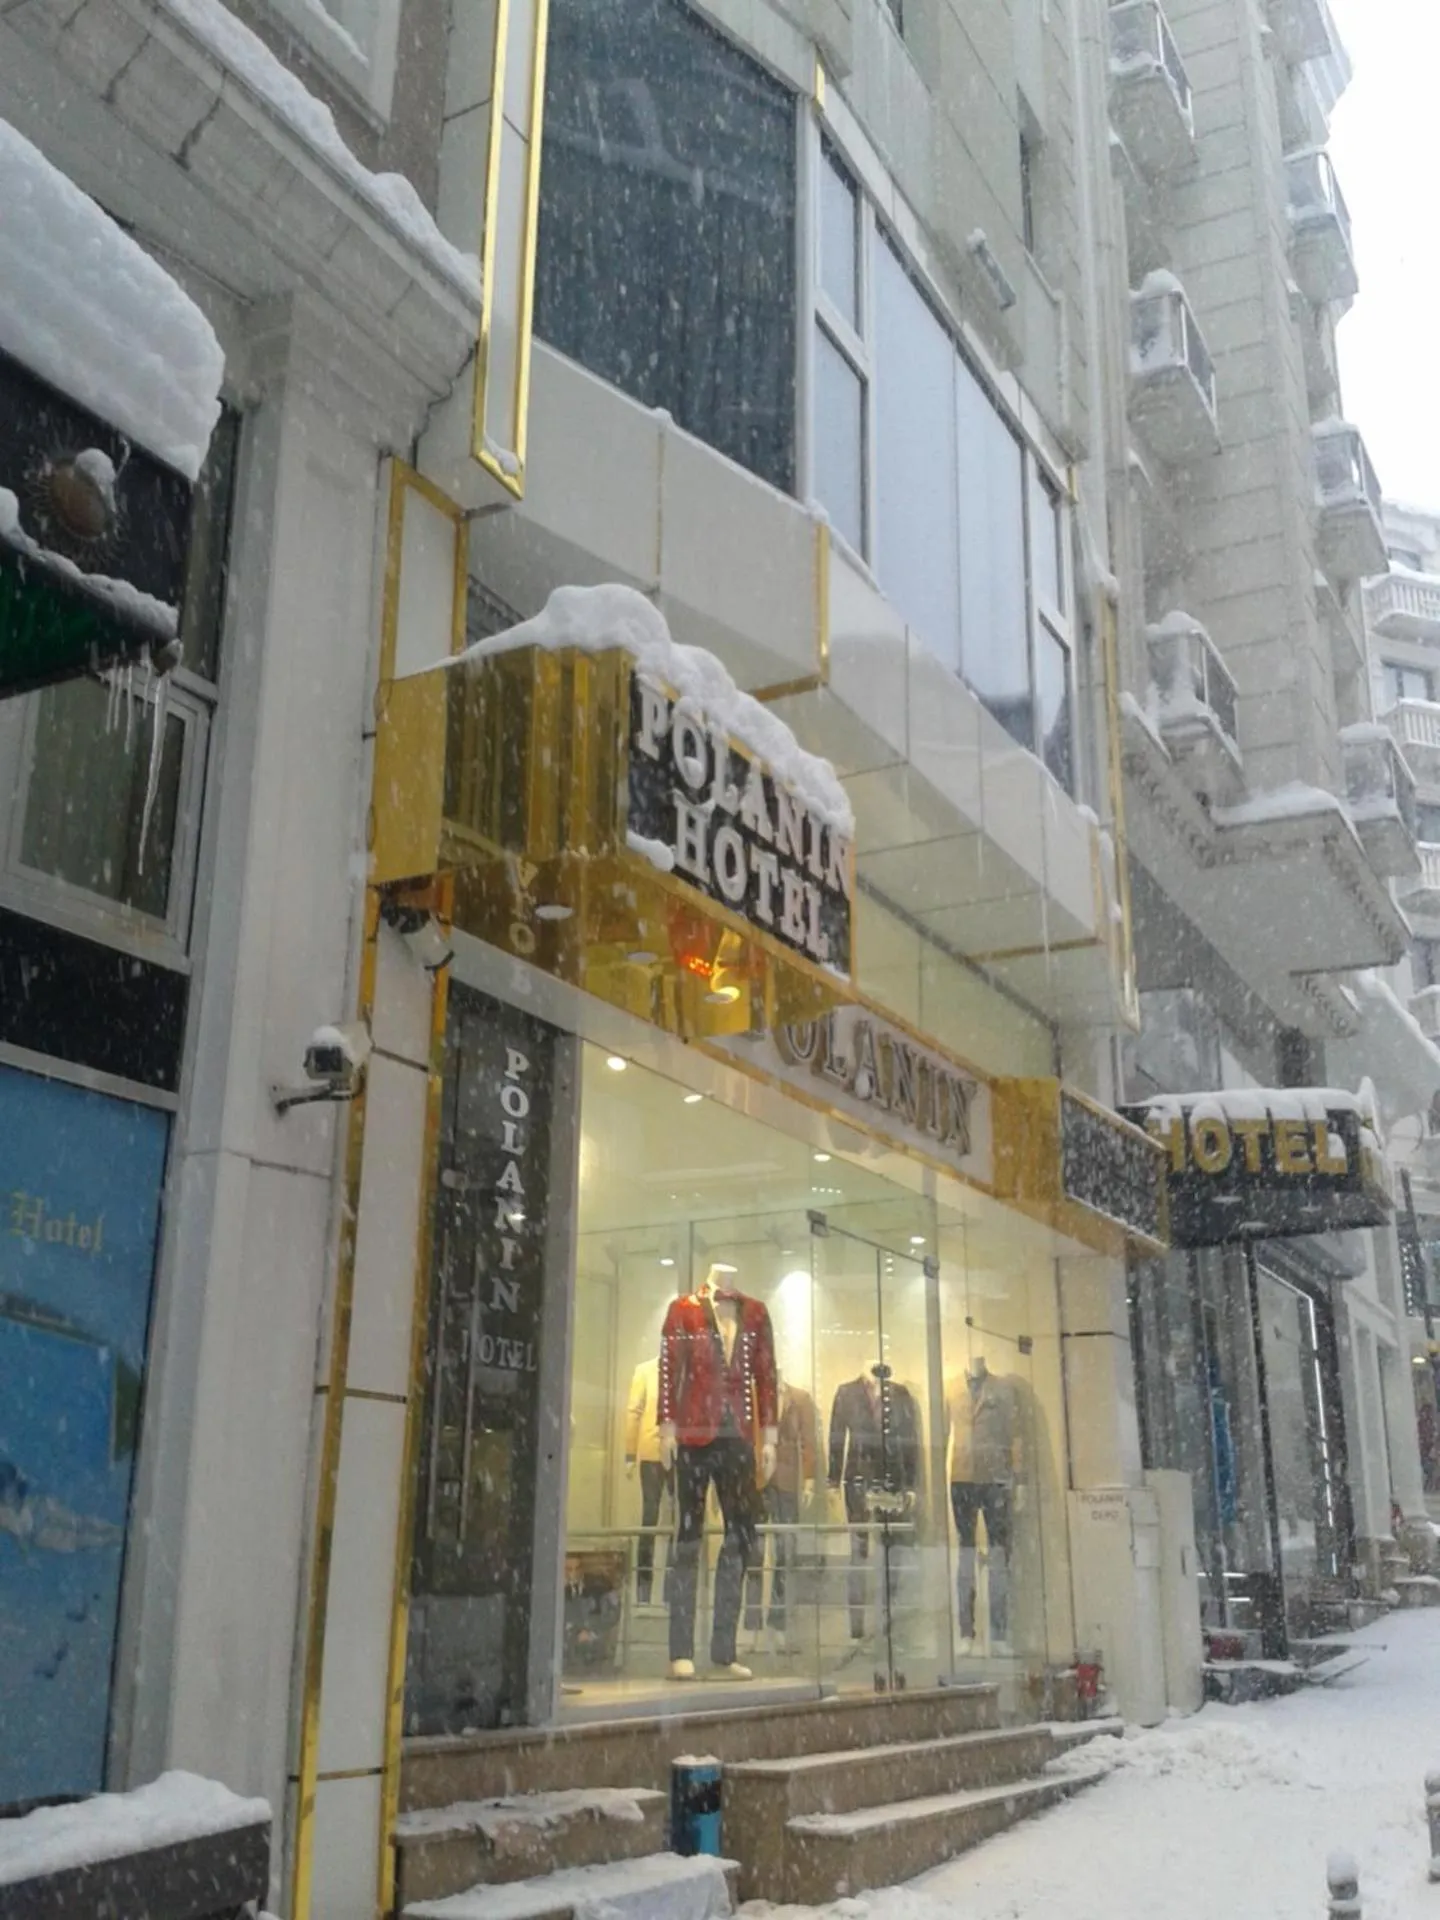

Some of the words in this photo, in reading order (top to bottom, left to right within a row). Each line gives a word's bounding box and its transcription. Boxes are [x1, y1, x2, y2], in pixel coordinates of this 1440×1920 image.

[669, 789, 829, 958] HOTEL
[778, 1010, 977, 1156] OLANIN
[1146, 1110, 1348, 1176] HOTEL
[9, 1191, 106, 1254] Hotel
[494, 1046, 531, 1315] POLANIN
